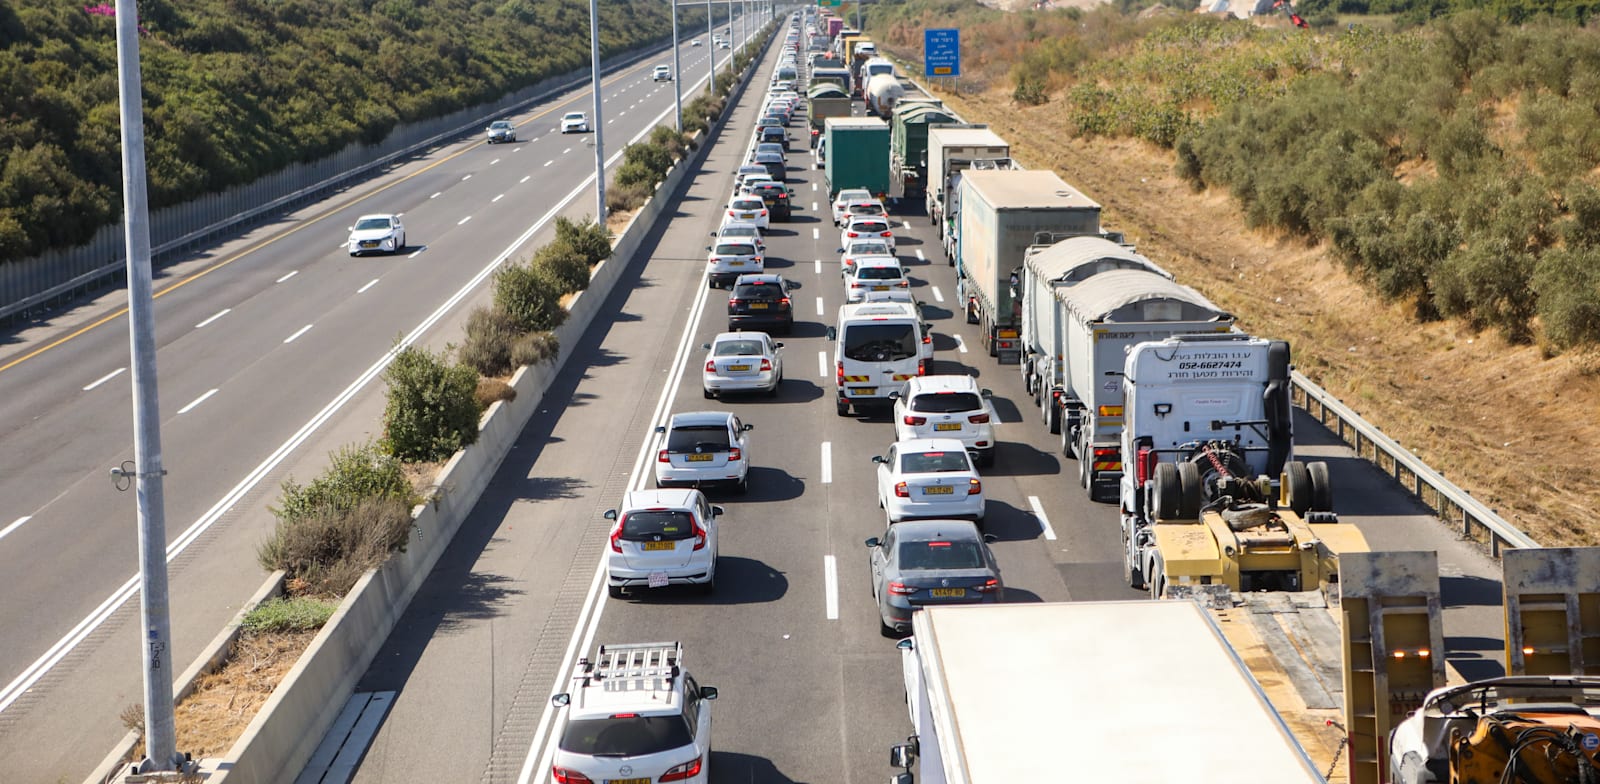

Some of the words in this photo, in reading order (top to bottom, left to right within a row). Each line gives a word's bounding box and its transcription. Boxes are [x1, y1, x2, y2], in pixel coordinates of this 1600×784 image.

[1194, 352, 1228, 360] הובלות
[1179, 361, 1242, 370] 052-6627474
[1193, 371, 1218, 379] מטען
